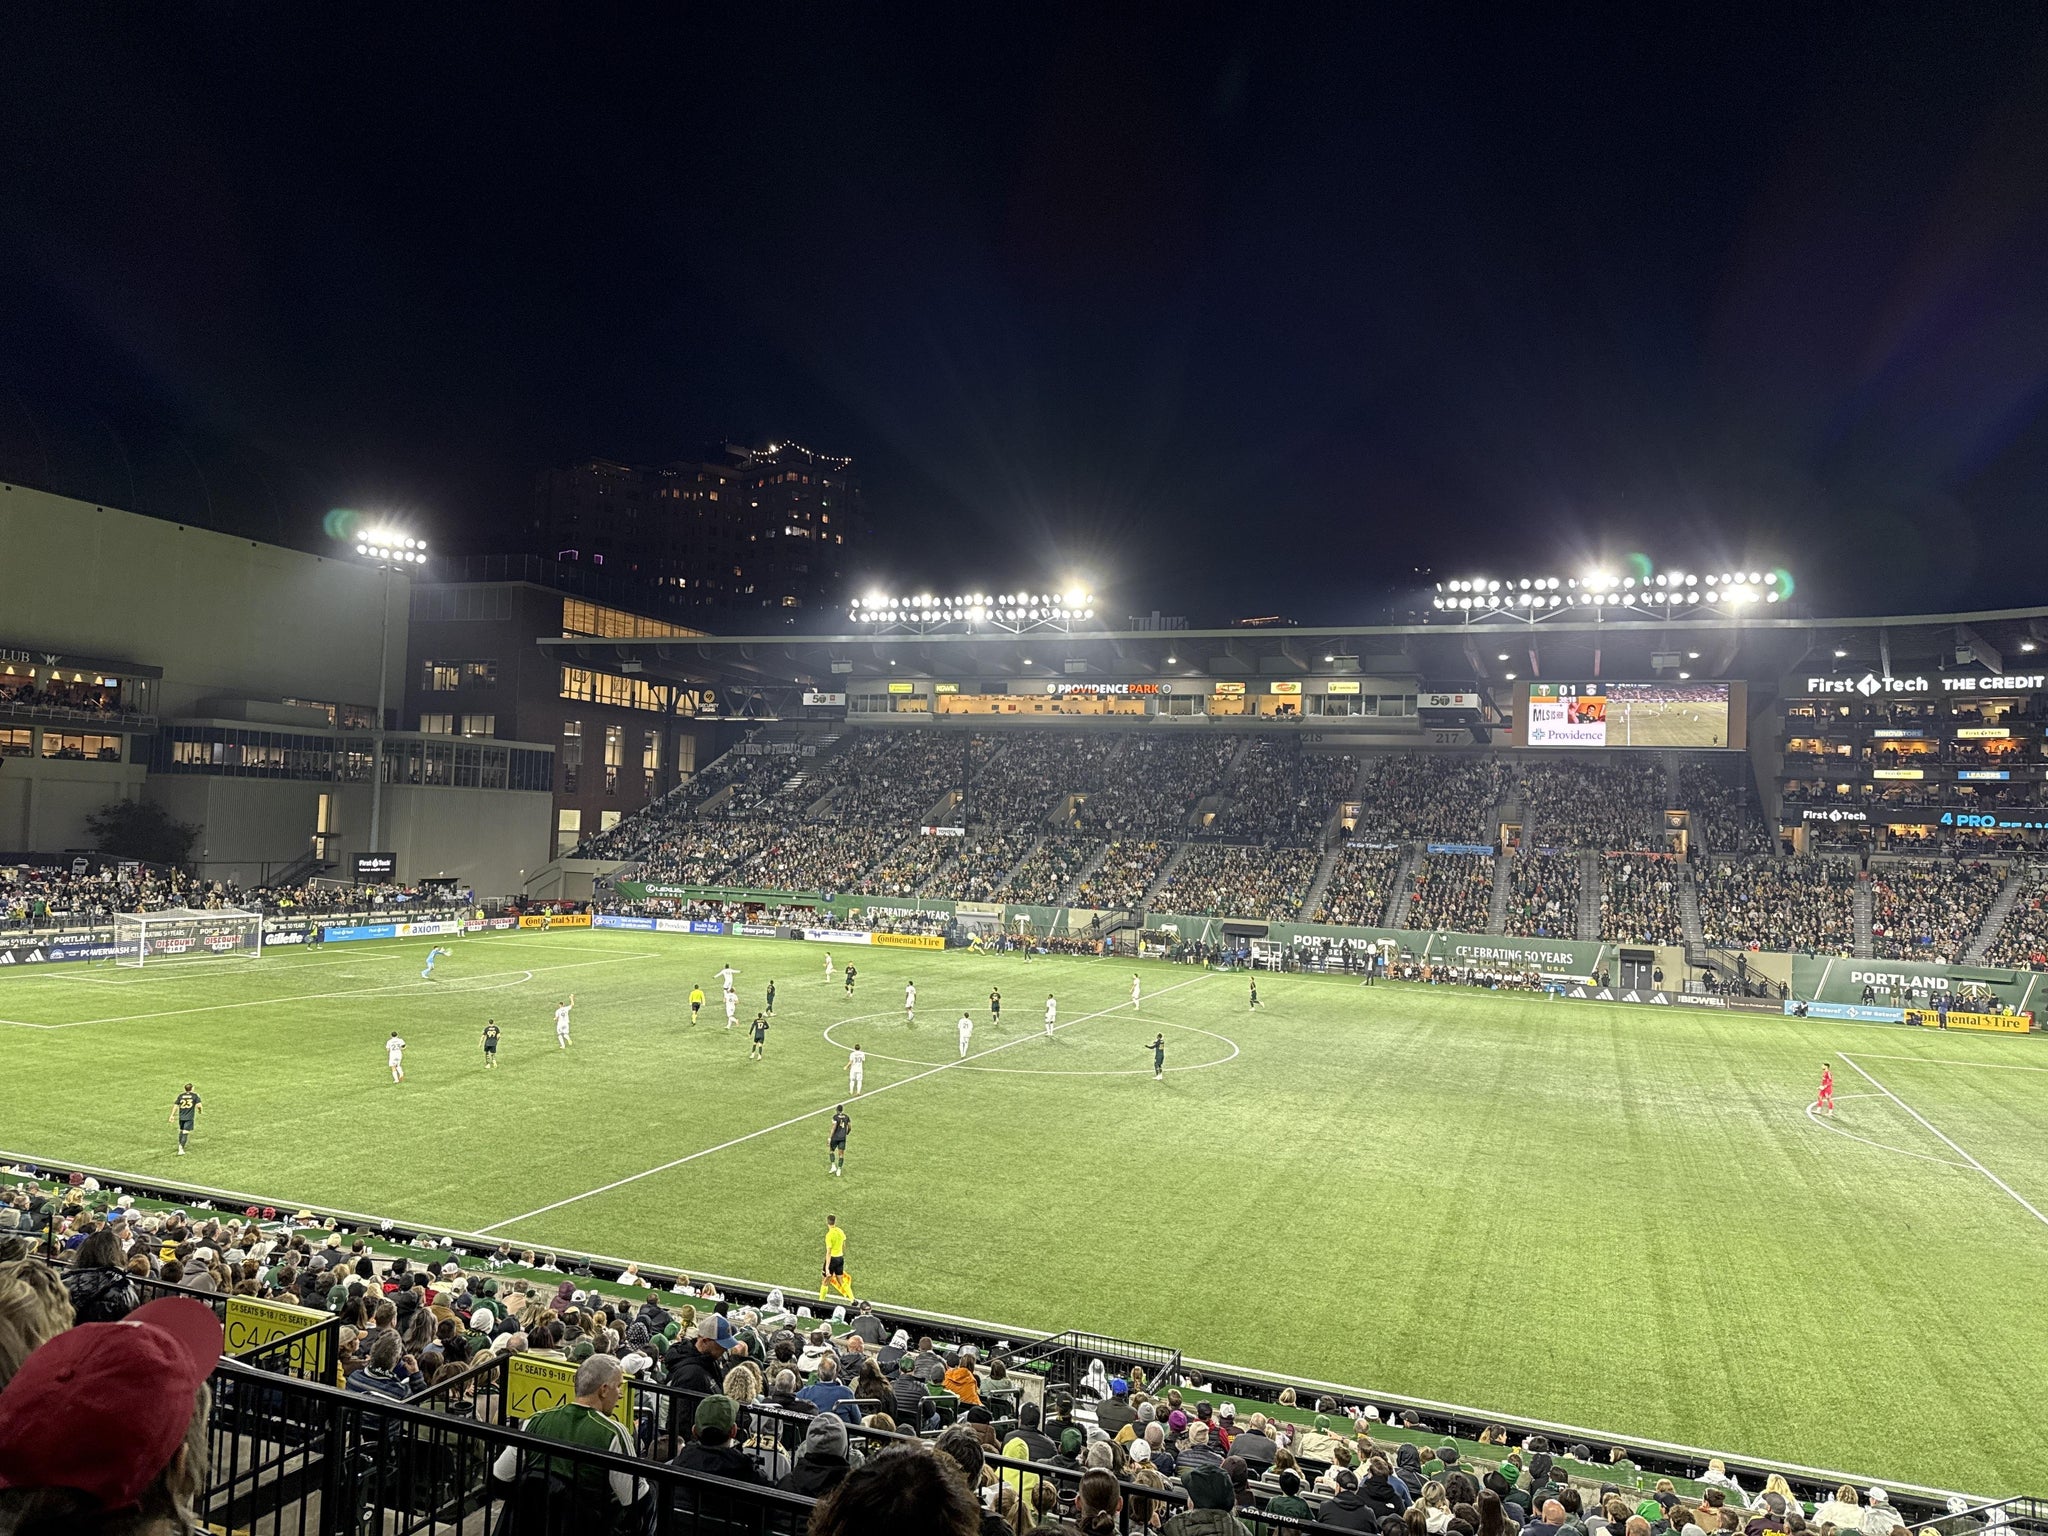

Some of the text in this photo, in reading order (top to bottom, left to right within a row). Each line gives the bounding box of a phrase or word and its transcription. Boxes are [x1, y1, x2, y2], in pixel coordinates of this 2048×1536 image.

[0, 650, 30, 662] LUB
[1808, 678, 1854, 692] First
[1882, 677, 1928, 692] Tech
[1942, 676, 2045, 690] THE CREDIT
[1058, 684, 1159, 694] PROVIDENCE PARK
[1559, 685, 1567, 696] 0
[1436, 733, 1459, 743] 217
[1548, 730, 1603, 740] Providence
[1803, 810, 1827, 820] First
[1842, 811, 1866, 821] Tech
[1940, 812, 1952, 825] 4
[1957, 815, 1996, 827] PRO
[927, 910, 950, 920] YEARS
[412, 924, 440, 934] axiom
[734, 926, 775, 934] enterprise
[20, 937, 38, 946] YEARS
[265, 932, 304, 945] Gillette
[877, 935, 916, 945] Continental
[1456, 946, 1573, 964] CELEBRATING 50 YEARS
[1851, 971, 1949, 990] PORTLAND
[1681, 996, 1725, 1006] BIDWELL
[1992, 1018, 2020, 1028] Tire
[180, 1099, 193, 1109] 23
[840, 1119, 845, 1128] 4
[240, 1306, 258, 1316] SEATS
[260, 1310, 274, 1319] 9-18
[288, 1316, 307, 1326] SEATS
[515, 1362, 523, 1371] C4
[525, 1365, 546, 1377] SEATS
[549, 1370, 565, 1381] 9-18
[778, 1410, 808, 1420] SECTION
[1241, 1507, 1299, 1524] ADA SECTION
